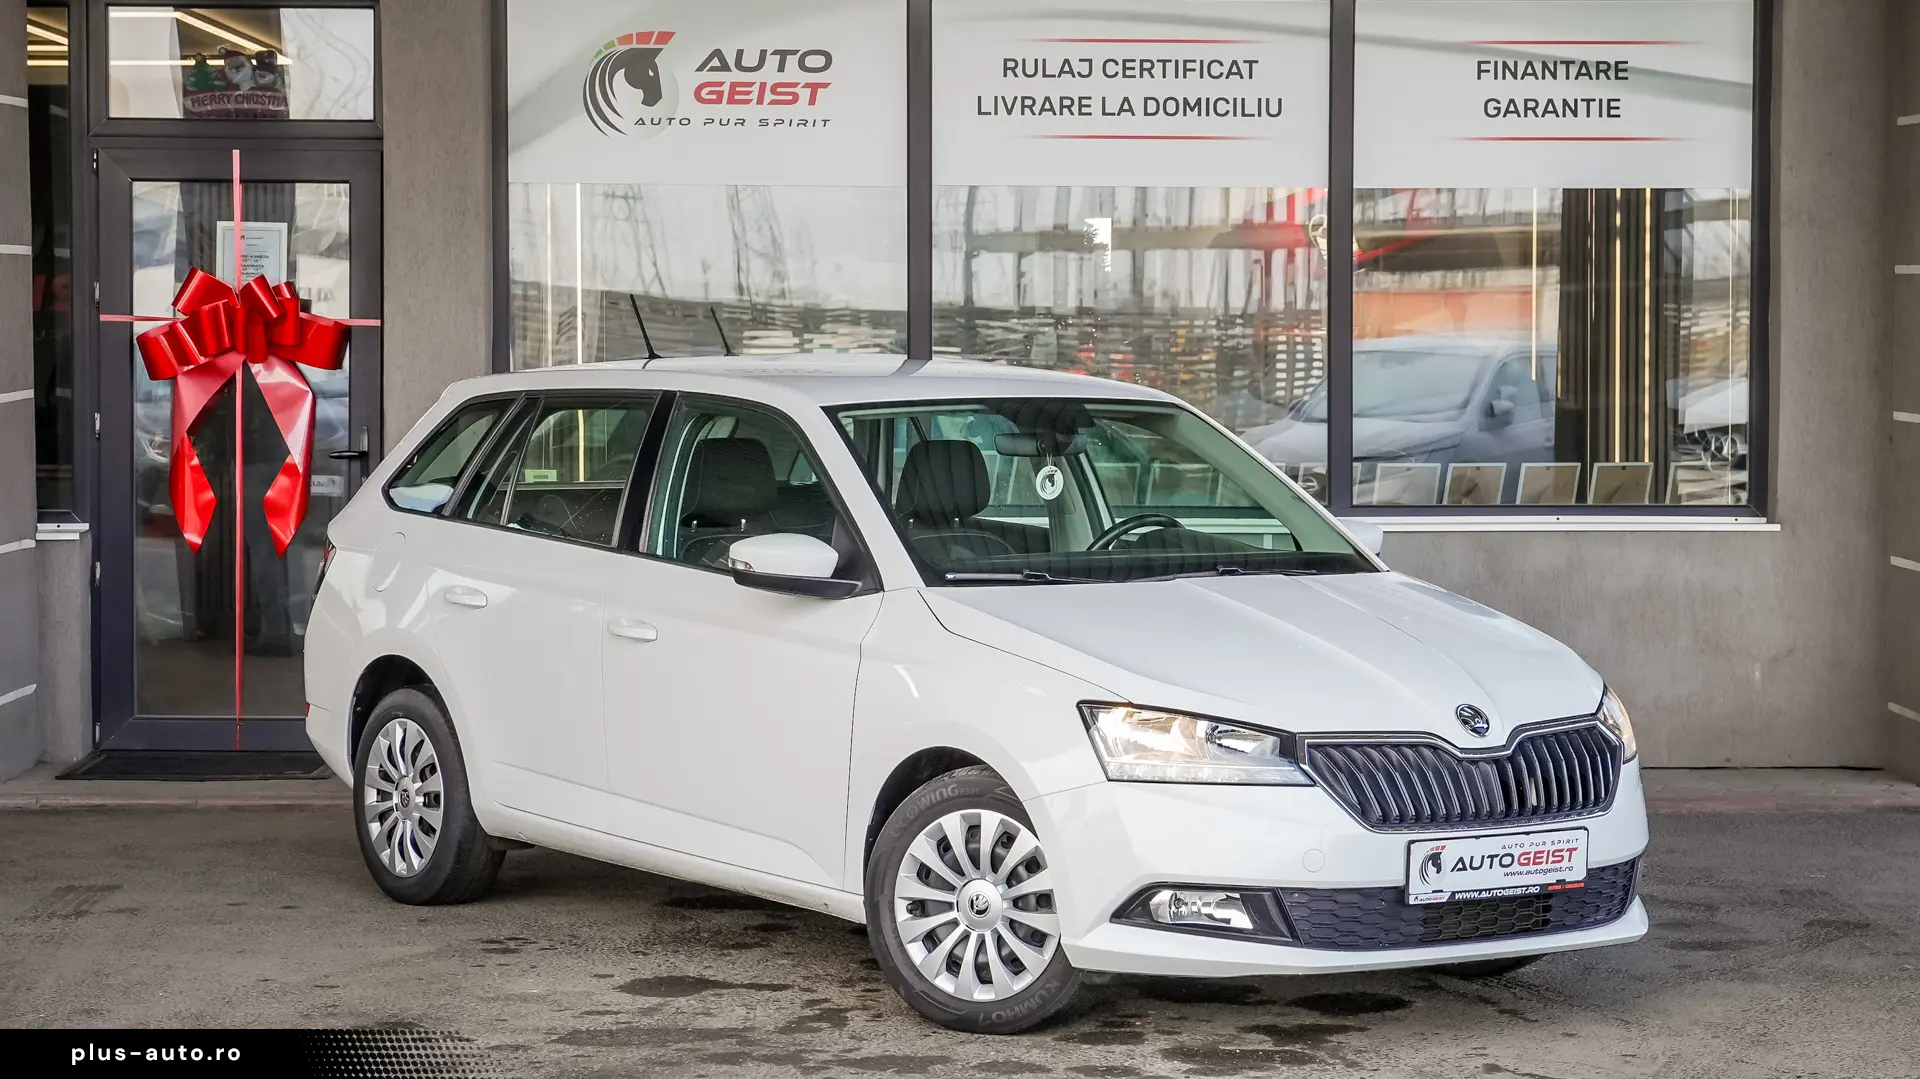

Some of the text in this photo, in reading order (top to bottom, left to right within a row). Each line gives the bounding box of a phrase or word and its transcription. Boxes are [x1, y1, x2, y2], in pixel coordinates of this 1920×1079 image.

[694, 48, 833, 74] AUTO
[1002, 58, 1259, 80] RULAJ CERTIFICAT
[1476, 60, 1629, 81] FINANTARE
[190, 93, 232, 108] MERRY
[693, 81, 832, 106] GEIST
[976, 95, 1283, 118] LIVRARE LA DOMICILIU
[1483, 98, 1621, 119] GARANTIE
[633, 117, 832, 128] AUTO PUR SPIRIT
[1501, 842, 1525, 850] AUTO
[1550, 838, 1580, 846] SPIRIT
[1503, 865, 1574, 877] www.autogeist.ro
[1455, 885, 1540, 900] WWW.AUTOGEIST.RO
